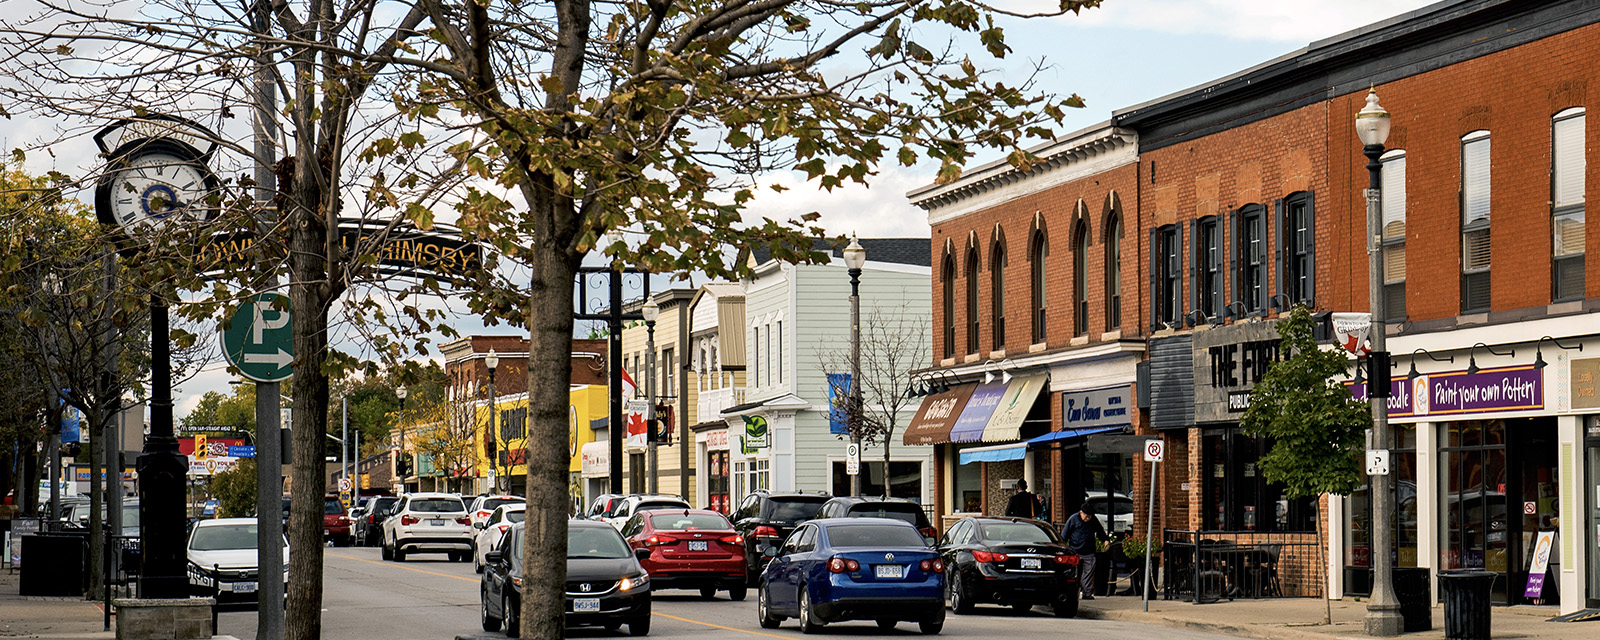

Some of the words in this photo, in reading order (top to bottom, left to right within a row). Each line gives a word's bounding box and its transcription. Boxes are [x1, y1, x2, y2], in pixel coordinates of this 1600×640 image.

[1209, 343, 1238, 388] THE
[1242, 339, 1291, 386] FORT
[1229, 394, 1251, 409] PUBLIC
[1387, 381, 1409, 410] oodle
[1434, 379, 1457, 407] Paint
[1459, 384, 1479, 410] your
[1481, 385, 1500, 403] own
[1502, 379, 1536, 406] Pottery
[1576, 385, 1595, 398] Owned
